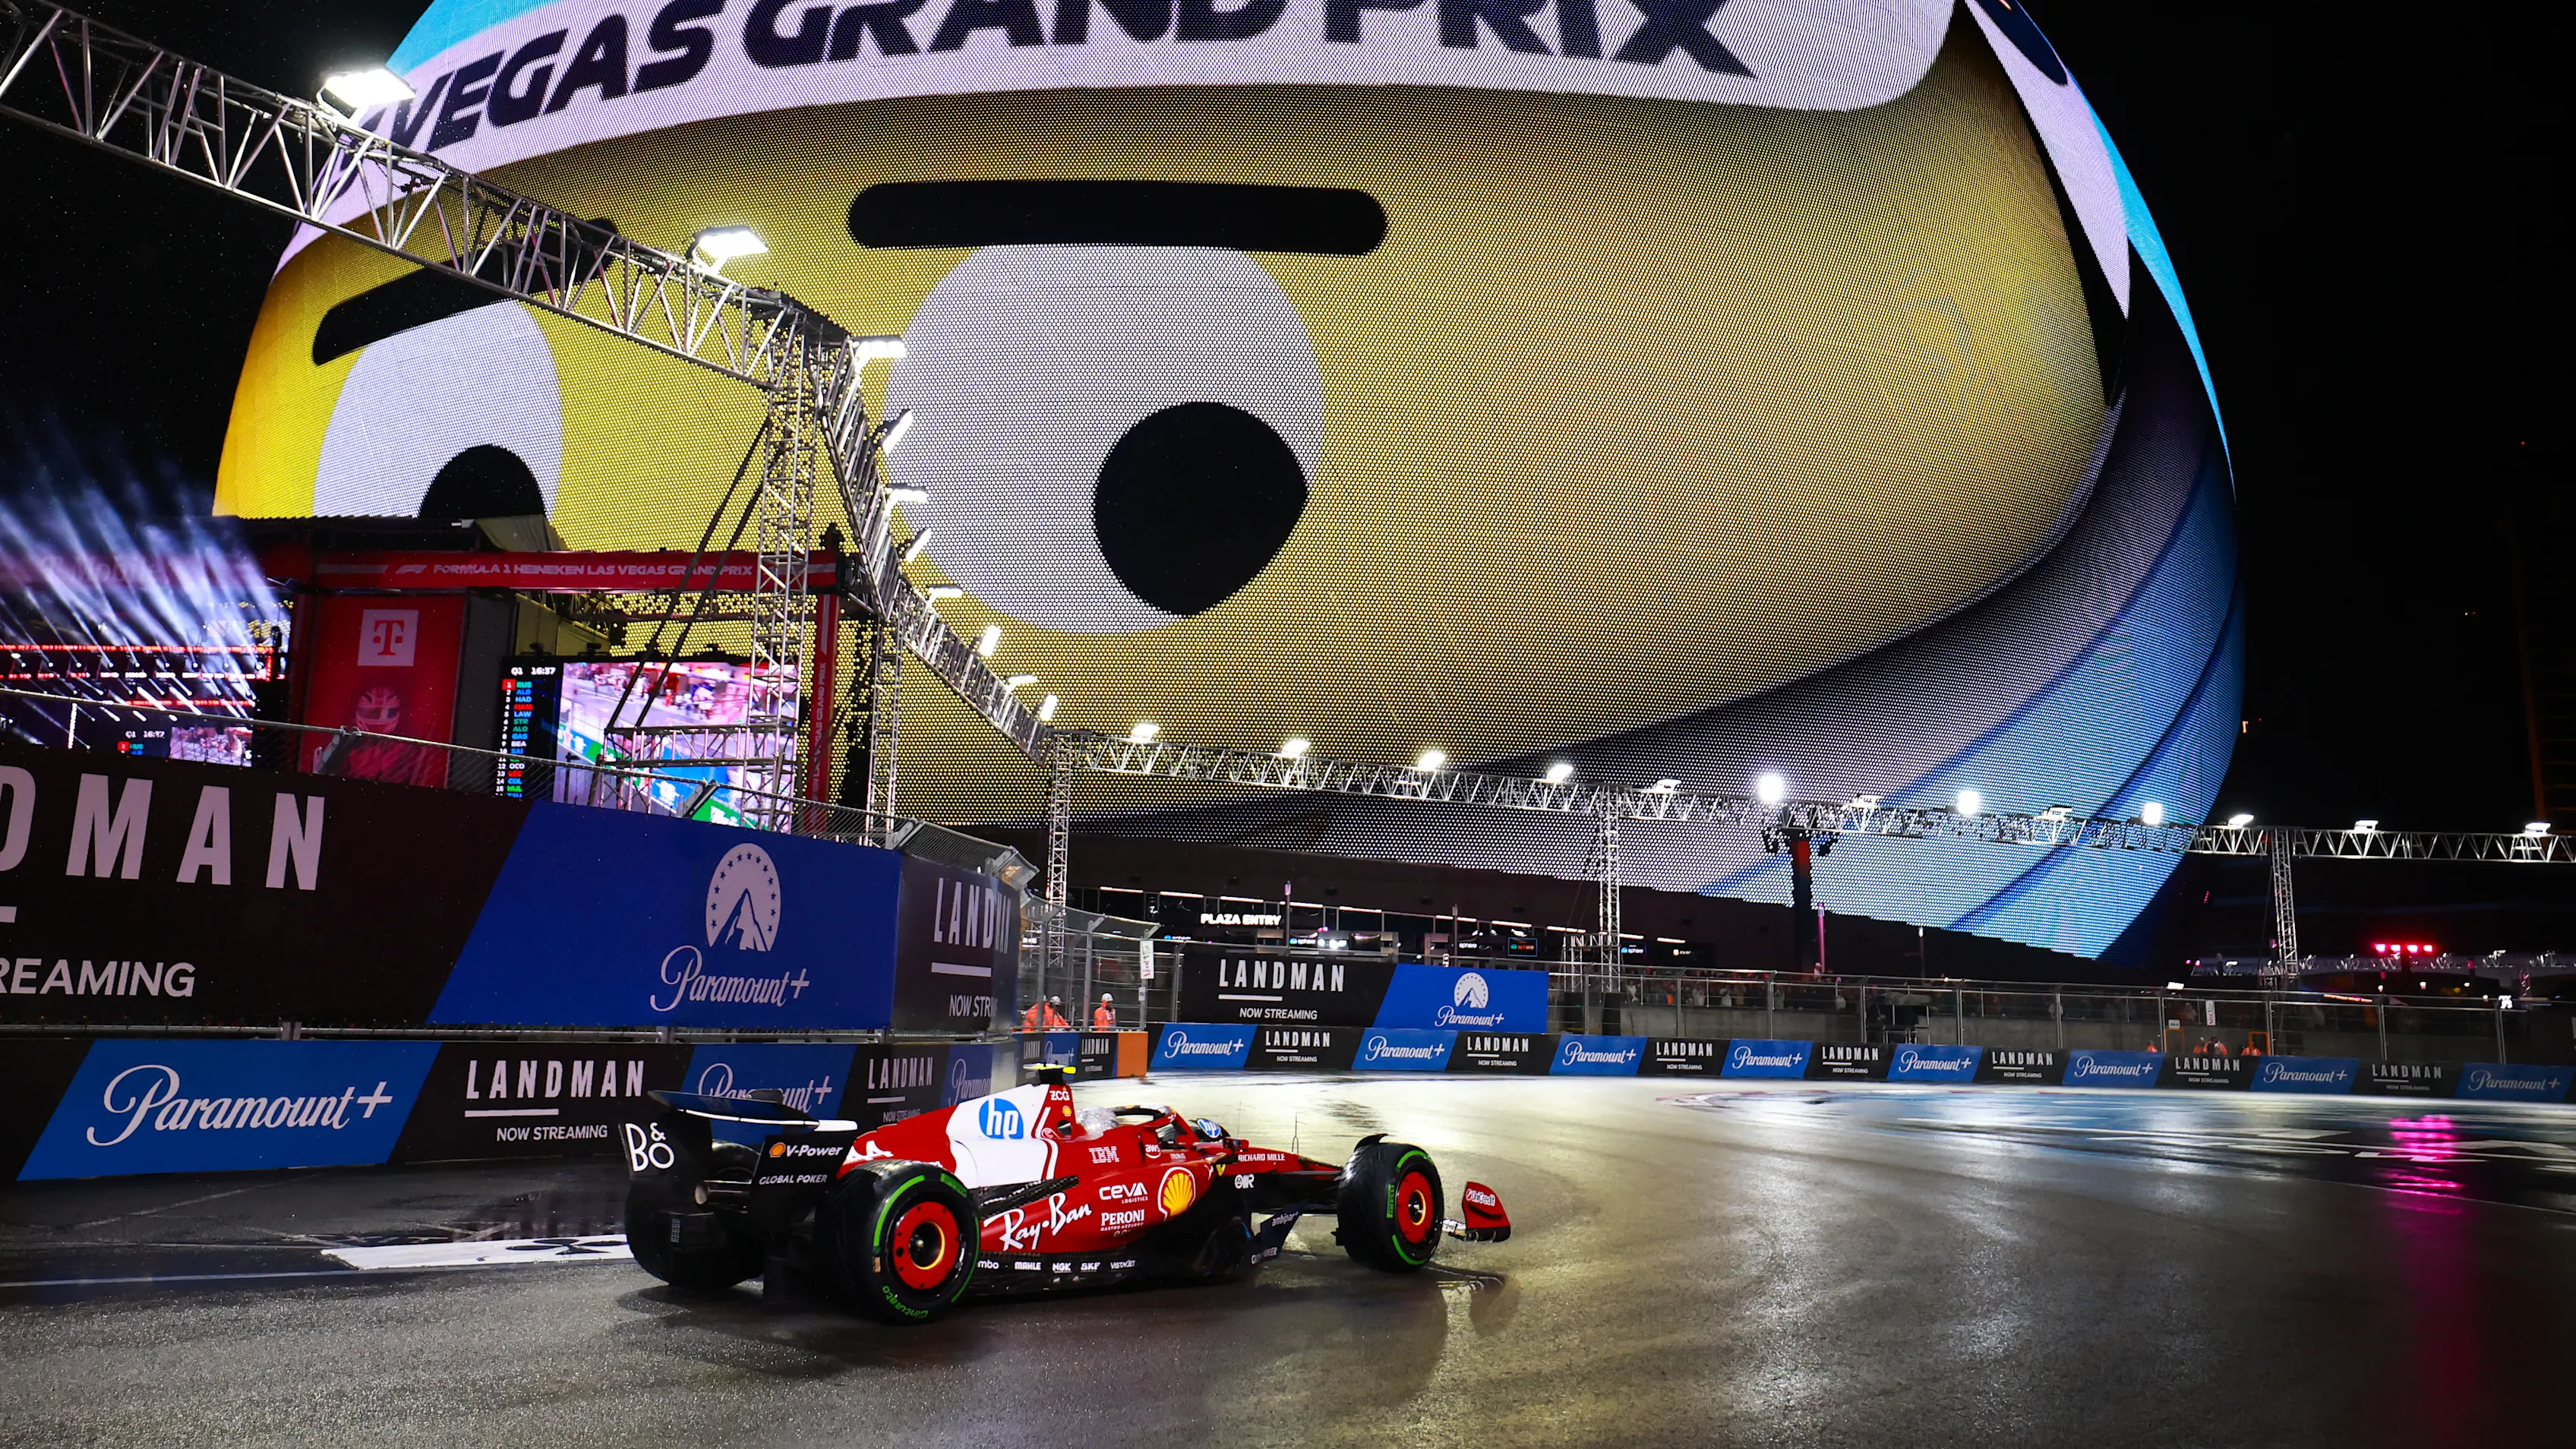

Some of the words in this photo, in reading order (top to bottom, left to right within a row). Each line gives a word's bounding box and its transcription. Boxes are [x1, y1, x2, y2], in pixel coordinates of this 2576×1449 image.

[390, 0, 728, 152] VEGAS
[434, 564, 500, 574] FORMULA
[504, 564, 511, 573] 1
[513, 564, 585, 575] HEINEKEN
[587, 565, 617, 575] LAS
[617, 565, 666, 575] VEGAS
[718, 565, 753, 576] PRIX
[511, 667, 523, 676] Q1
[531, 667, 556, 675] 16:37
[1201, 914, 1241, 925] PLAZA
[1242, 914, 1282, 926] ENTRY
[650, 945, 810, 1012] Paramount+
[1218, 959, 1344, 992] LANDMAN
[950, 995, 973, 1017] NOW
[1239, 1007, 1263, 1018] NOW
[1264, 1008, 1318, 1020] STREAMING
[1435, 1005, 1504, 1027] Paramount+
[1081, 1038, 1110, 1055] LANDMAN
[1164, 1031, 1244, 1059] Paramount+
[1265, 1031, 1331, 1047] LANDMAN
[1467, 1036, 1530, 1053] LANDMAN
[1365, 1036, 1445, 1061] Paramount+
[1562, 1041, 1637, 1065] Paramount+
[1656, 1041, 1713, 1056] LANDMAN
[1823, 1046, 1879, 1061] LANDMAN
[1732, 1046, 1803, 1069] Paramount+
[1899, 1050, 1971, 1073] Paramount+
[1992, 1051, 2053, 1065] LANDMAN
[2175, 1056, 2240, 1072] LANDMAN
[466, 1060, 644, 1100] LANDMAN
[868, 1057, 933, 1089] LANDMAN
[2468, 1069, 2560, 1091] Paramount+
[1050, 1091, 1070, 1100] ZCG
[87, 1065, 393, 1146] Paramount+
[983, 1098, 1021, 1139] hp
[497, 1127, 530, 1141] NOW
[532, 1124, 608, 1141] STREAMING
[786, 1143, 843, 1157] V-Power
[1088, 1146, 1120, 1163] IBM
[1145, 1144, 1161, 1154] aws
[1238, 1154, 1265, 1162] RICHARD
[1267, 1153, 1286, 1161] MILLE
[759, 1175, 794, 1185] GLOBAL
[795, 1174, 828, 1184] POKER
[1472, 1190, 1496, 1207] UniCredit
[1101, 1209, 1144, 1226] PERONI
[1015, 1261, 1041, 1271] MAHLE
[1052, 1262, 1072, 1271] NGK
[1081, 1261, 1100, 1271] SKF
